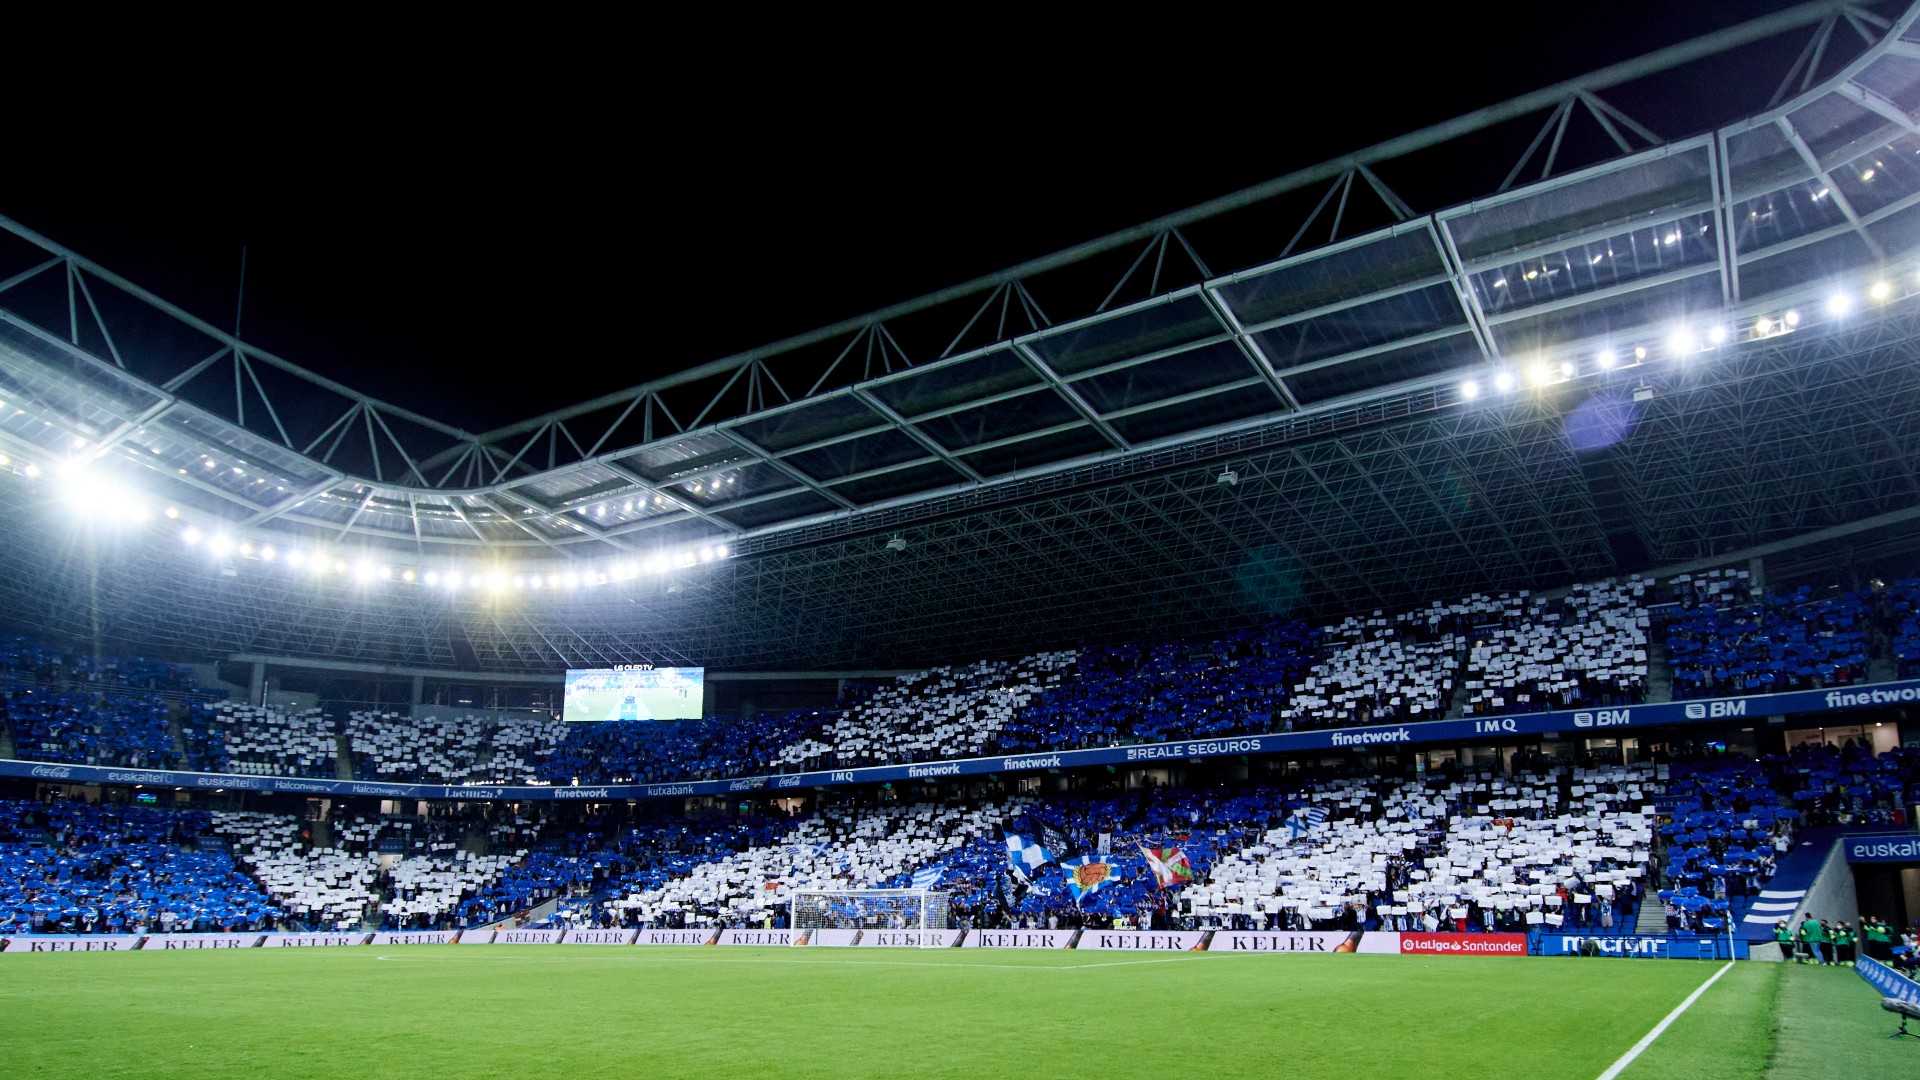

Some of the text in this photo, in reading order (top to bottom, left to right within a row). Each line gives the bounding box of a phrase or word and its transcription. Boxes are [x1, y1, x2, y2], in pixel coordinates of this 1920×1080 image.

[1710, 700, 1746, 718] BM
[1596, 709, 1630, 726] BM
[1476, 718, 1518, 733] IMQ
[1331, 728, 1410, 746] finetwork
[1137, 739, 1261, 759] REALE SEGUROS
[1003, 755, 1061, 770] finetwork
[908, 763, 960, 777] finetwork
[108, 772, 163, 783] euskaltel
[198, 777, 250, 788] euskaltel
[831, 771, 854, 782] IMQ
[554, 788, 608, 798] finetwork
[647, 784, 694, 796] kutxabank
[282, 938, 349, 947] KELER
[389, 934, 445, 944] KELER
[505, 932, 551, 943] KELER
[575, 932, 623, 943] KELER
[650, 933, 702, 944] KELER
[732, 933, 790, 945] KELER
[877, 933, 943, 946] KELER
[981, 934, 1055, 947] KELER
[1100, 935, 1183, 949] KELER
[1232, 936, 1326, 951] KELER
[31, 941, 118, 951] KELER
[165, 939, 241, 950] KELER
[1415, 939, 1523, 952] LaLiga Santander
